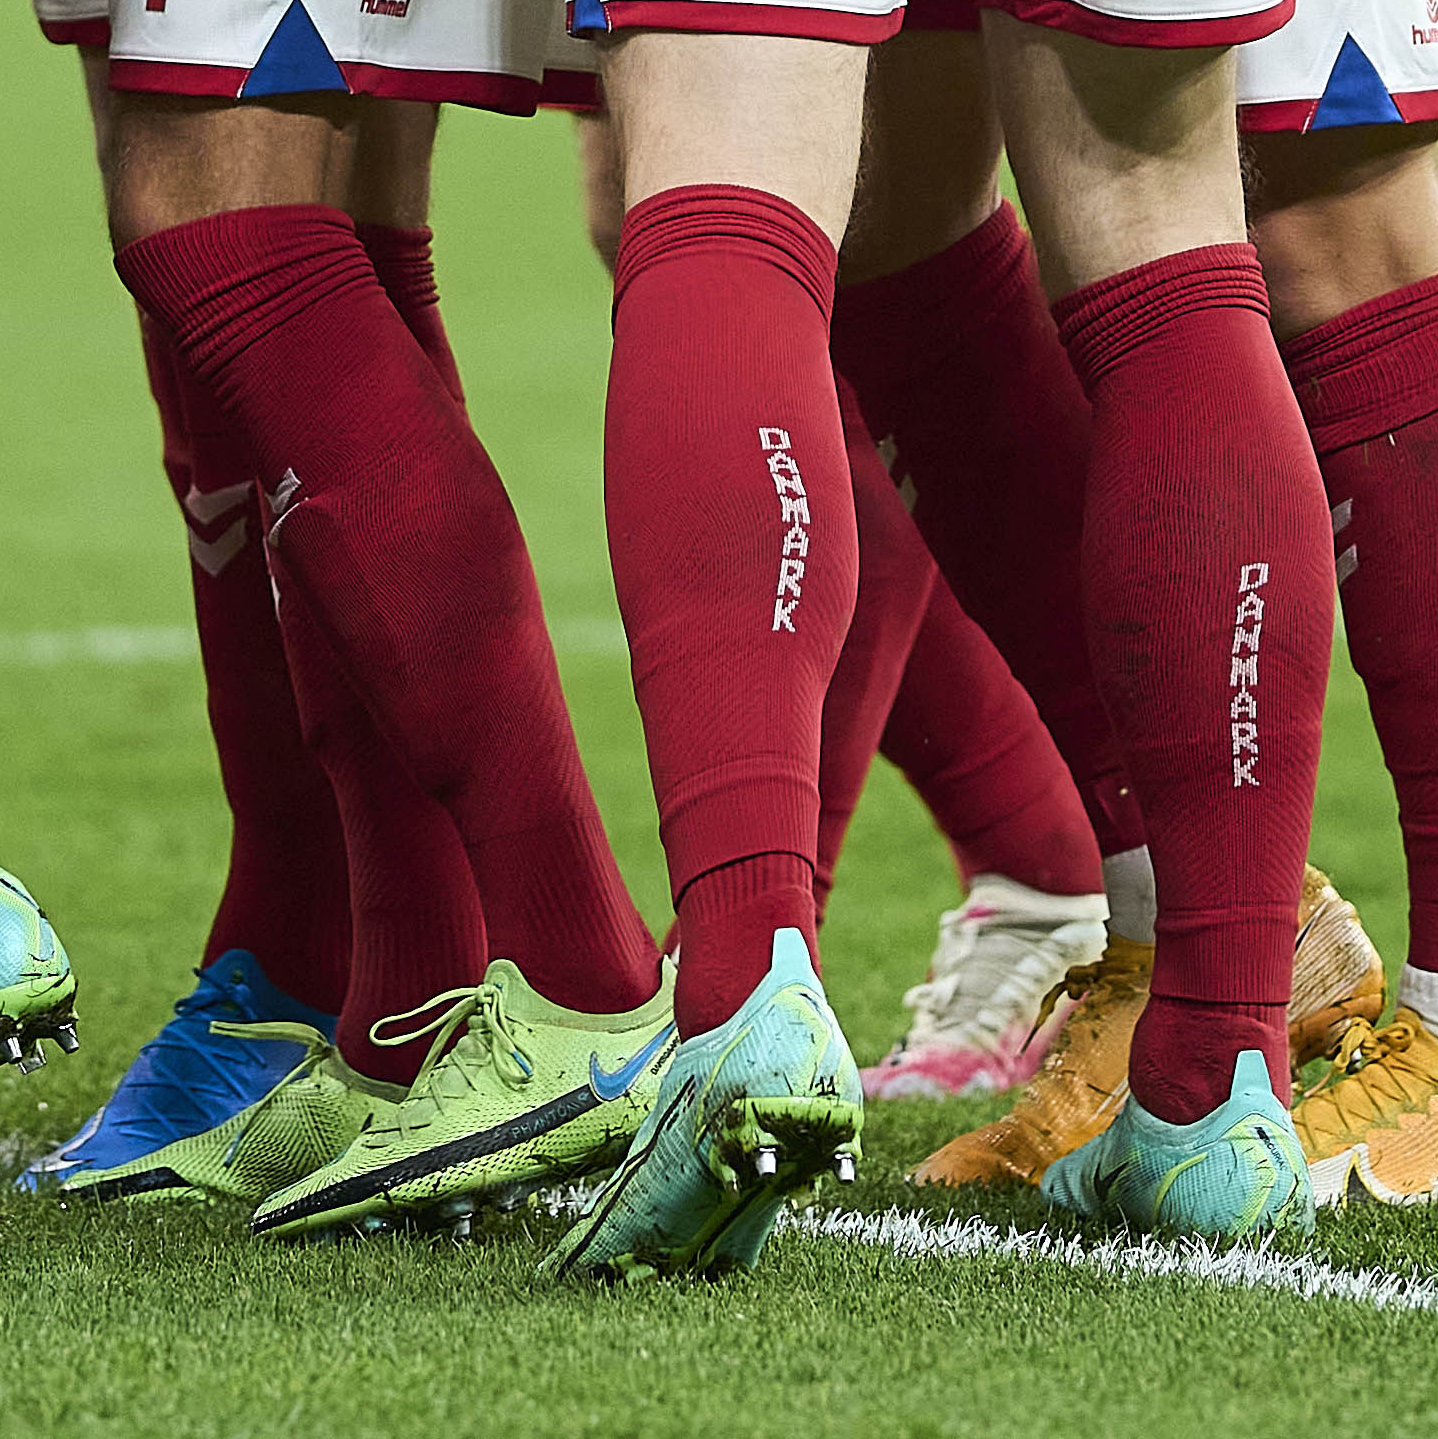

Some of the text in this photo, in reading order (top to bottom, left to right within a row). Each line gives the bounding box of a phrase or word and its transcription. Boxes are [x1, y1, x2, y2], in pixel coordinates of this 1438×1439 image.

[758, 427, 810, 633] DANMARK
[1229, 562, 1269, 787] DANMARK
[510, 1101, 584, 1140] PHANTOM
